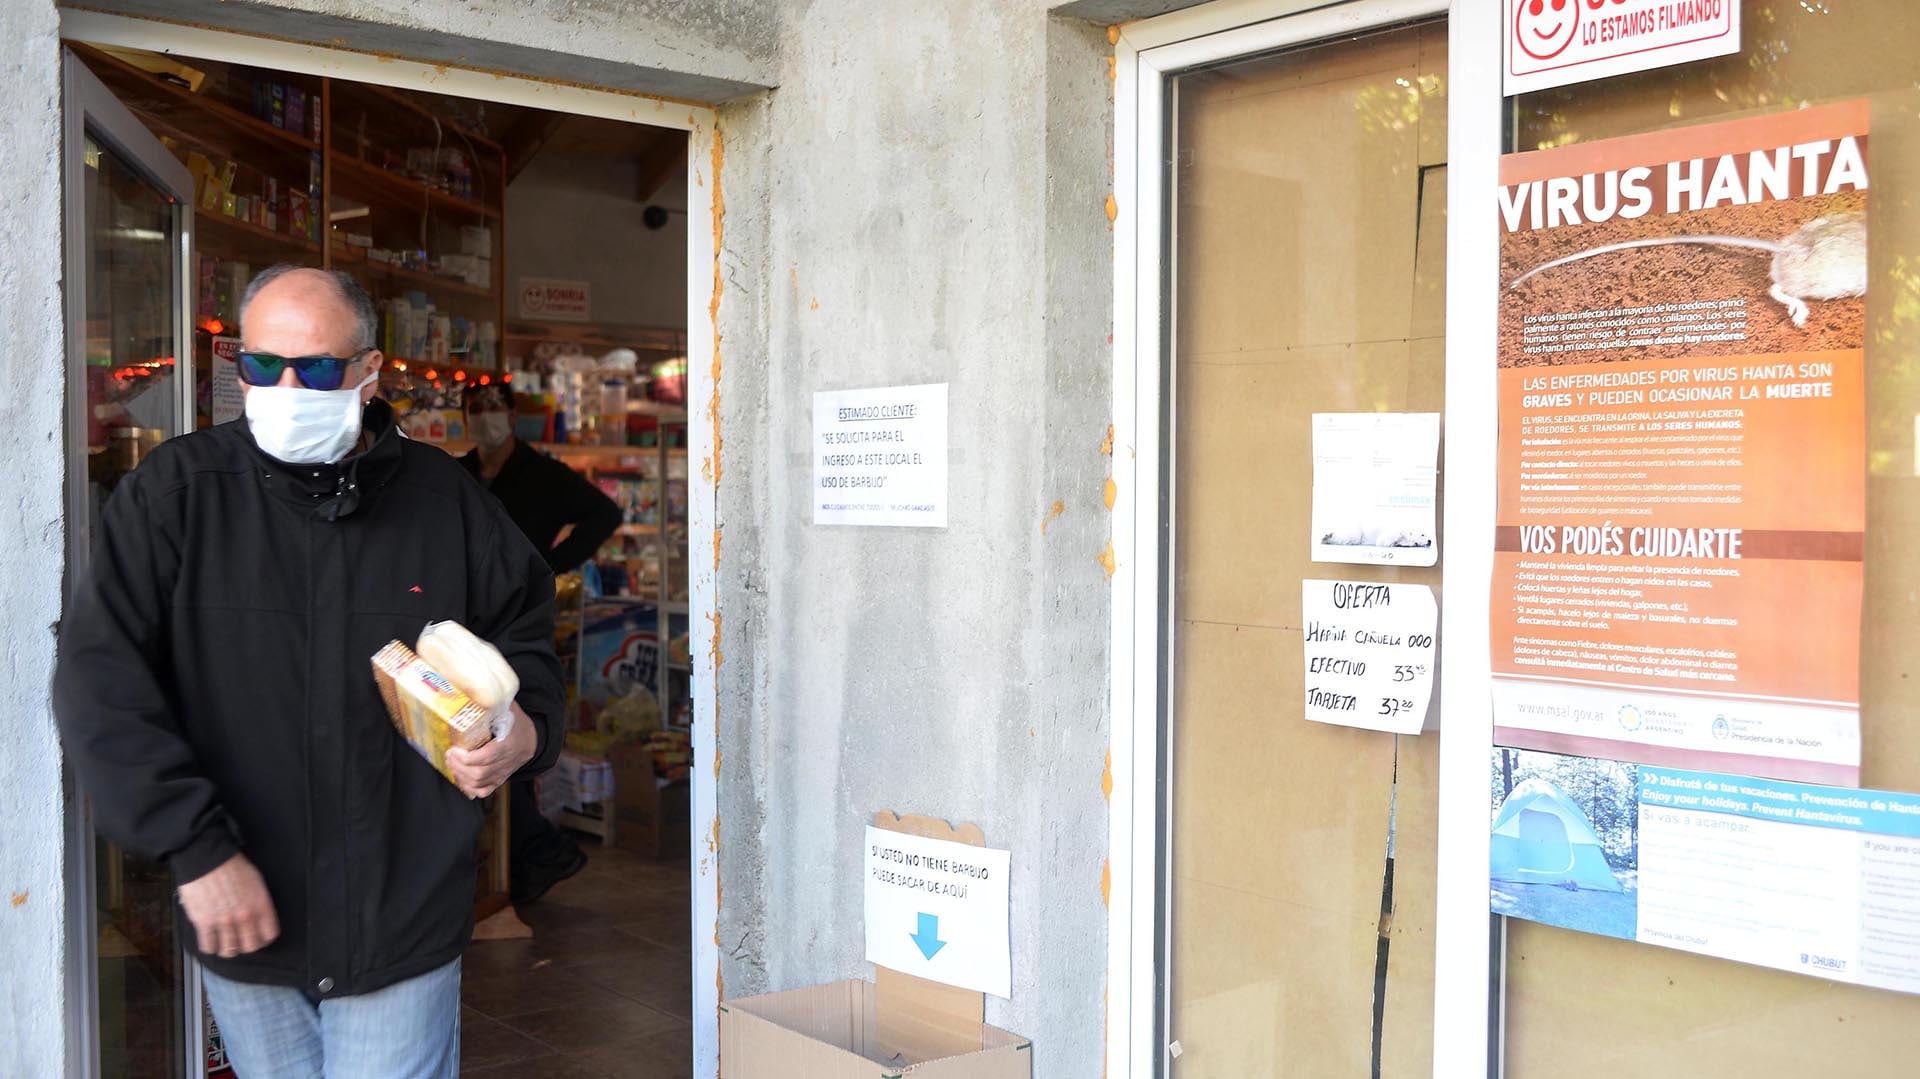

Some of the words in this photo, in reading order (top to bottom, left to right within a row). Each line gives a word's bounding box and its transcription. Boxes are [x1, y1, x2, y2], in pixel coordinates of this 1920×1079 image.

[1582, 21, 1597, 46] LO
[1600, 8, 1655, 42] ESTAMOS
[1658, 0, 1722, 31] FILMANDO
[1498, 166, 1653, 233] VIRUS
[1666, 134, 1869, 215] HANTA
[1523, 324, 1560, 335] palmente
[1566, 321, 1594, 331] ratones
[1595, 317, 1636, 328] conocidos
[1637, 315, 1660, 325] como
[1706, 311, 1722, 320] Los
[1723, 309, 1747, 318] seres
[1524, 315, 1537, 324] Los
[1556, 312, 1577, 321] hanta
[1578, 308, 1608, 319] infectan
[1615, 307, 1622, 316] la
[1654, 303, 1665, 313] de
[1666, 302, 1677, 312] los
[1523, 335, 1559, 344] humanos
[1562, 333, 1586, 341] tienen
[1589, 329, 1613, 340] riesgo
[1615, 328, 1626, 337] de
[1629, 326, 1661, 336] contraer
[1665, 321, 1727, 334] enfermedades
[1730, 320, 1747, 330] por
[1523, 344, 1541, 354] virus
[1542, 343, 1563, 353] hanta
[1564, 343, 1575, 351] en
[1575, 341, 1596, 351] todas
[1597, 338, 1628, 351] aquellas
[1629, 338, 1653, 347] zonas
[1654, 335, 1683, 345] donde
[1684, 334, 1702, 345] hay
[1523, 376, 1547, 391] LAS
[1550, 370, 1656, 390] ENFERMEDADES
[1660, 368, 1689, 384] POR
[1692, 367, 1738, 383] VIRUS
[1742, 364, 1795, 380] HANTA
[1798, 362, 1833, 378] SON
[1522, 393, 1572, 408] GRAVES
[1575, 392, 1585, 405] Y
[1589, 390, 1643, 405] PUEDEN
[1649, 385, 1733, 403] OCASIONAR
[1739, 384, 1760, 400] LA
[1765, 382, 1833, 399] MUERTE
[839, 406, 879, 420] ESTIMADO
[881, 404, 918, 418] CLIENTE:
[1522, 416, 1530, 425] EL
[1554, 415, 1563, 423] SE
[1563, 413, 1606, 423] ENCUENTRA
[1606, 412, 1617, 422] EN
[1617, 412, 1627, 421] LA
[1653, 411, 1662, 420] LA
[1663, 410, 1689, 420] SALIVA
[1689, 410, 1696, 419] Y
[1696, 409, 1707, 419] LA
[1707, 408, 1744, 418] EXCRETA
[836, 431, 870, 444] SOLICITA
[872, 430, 893, 442] PARA
[895, 429, 904, 442] EL
[1522, 426, 1532, 435] DE
[1534, 425, 1577, 434] ROEDORES,
[1578, 424, 1588, 433] SE
[1592, 423, 1637, 433] TRANSMITE
[1638, 422, 1645, 431] A
[1647, 422, 1662, 431] LOS
[1664, 421, 1693, 431] SERES
[822, 453, 856, 467] INGRESO
[857, 454, 863, 465] A
[865, 453, 883, 466] ESTE
[885, 452, 911, 466] LOCAL
[913, 452, 922, 465] EL
[821, 476, 838, 488] USO
[839, 476, 849, 488] DE
[1519, 525, 1556, 554] VOS
[1561, 520, 1624, 556] PODÉS
[1629, 526, 1743, 559] CUIDARTE
[1557, 561, 1585, 571] vivienda
[1608, 564, 1624, 573] para
[1653, 565, 1690, 576] presencia
[1691, 566, 1702, 575] de
[1333, 582, 1391, 610] OFERTA
[1608, 586, 1619, 595] del
[1354, 629, 1402, 646] CAÑUELA
[1408, 634, 1433, 649] 000
[1309, 656, 1367, 677] EFECTIVO
[1308, 687, 1357, 712] TARJETA
[1642, 788, 1672, 804] Enjoy
[1673, 794, 1700, 805] your
[1752, 802, 1794, 817] Prevent
[1704, 780, 1718, 792] de
[1721, 782, 1739, 793] tus
[1801, 791, 1868, 810] Prevención
[1870, 800, 1886, 812] de
[1643, 809, 1653, 820] Si
[872, 845, 879, 858] SI
[880, 848, 904, 865] USTED
[905, 853, 920, 868] NO
[922, 856, 949, 872] TIENE
[952, 861, 989, 881] BARBIJO
[872, 867, 896, 885] PUEDE
[897, 875, 925, 892] SACAR
[927, 880, 941, 894] DE
[1811, 954, 1848, 970] CHUBUT
